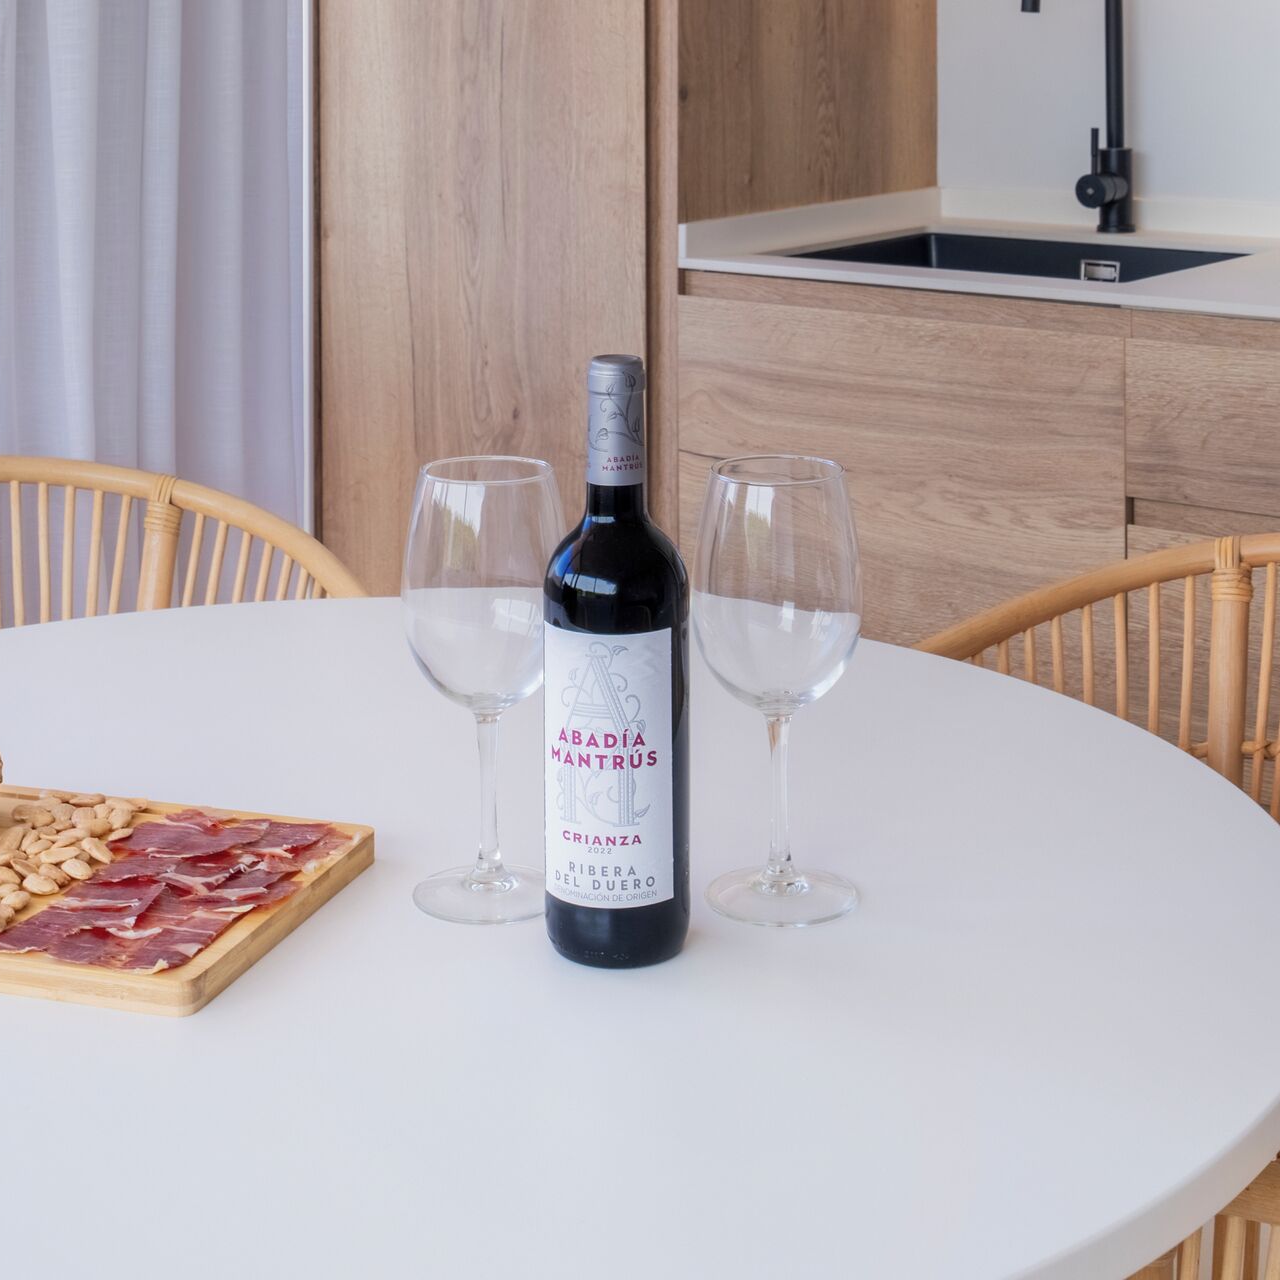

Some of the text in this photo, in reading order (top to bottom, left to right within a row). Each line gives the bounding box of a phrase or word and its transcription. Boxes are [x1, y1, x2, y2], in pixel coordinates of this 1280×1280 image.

[558, 727, 647, 749] ABADÍA
[551, 744, 658, 771] MANTRÚS
[562, 830, 642, 847] CRIANZA
[587, 846, 613, 855] 2022
[568, 861, 638, 877] RIBERA
[555, 870, 657, 892] DEL DUERO
[612, 893, 624, 903] DE
[625, 889, 658, 902] ORIGEN
